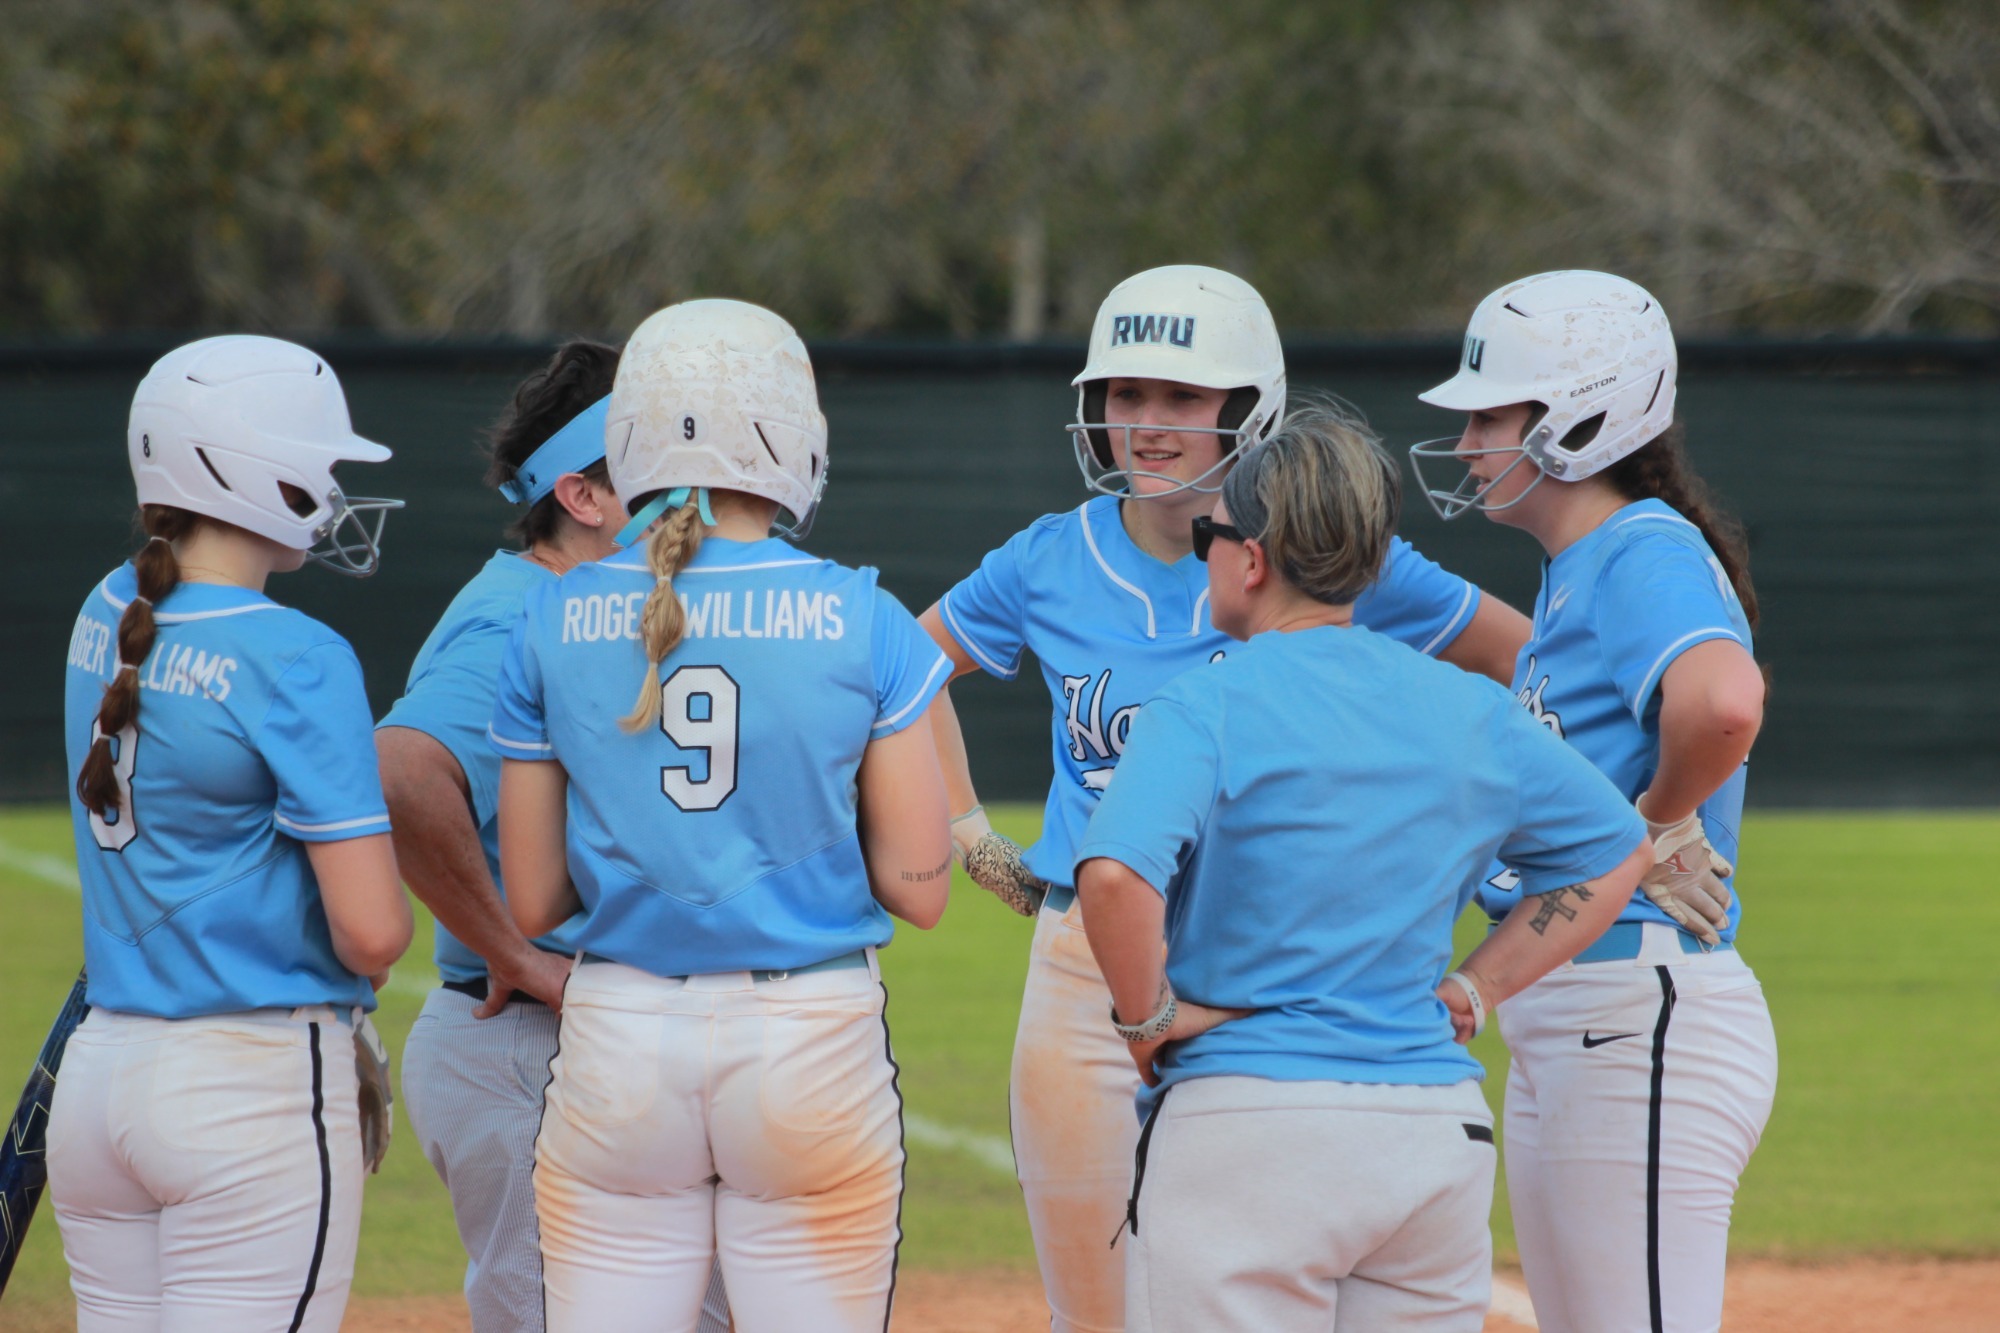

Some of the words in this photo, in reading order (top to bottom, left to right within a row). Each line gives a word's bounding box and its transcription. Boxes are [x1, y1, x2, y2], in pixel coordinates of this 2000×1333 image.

[1111, 314, 1195, 349] RWU
[1570, 374, 1617, 398] EASTON
[142, 433, 151, 459] 8
[683, 416, 696, 441] 9
[562, 591, 651, 644] ROGE
[680, 589, 845, 641] WILLIAMS
[68, 613, 111, 676] OGER
[660, 664, 741, 814] 9
